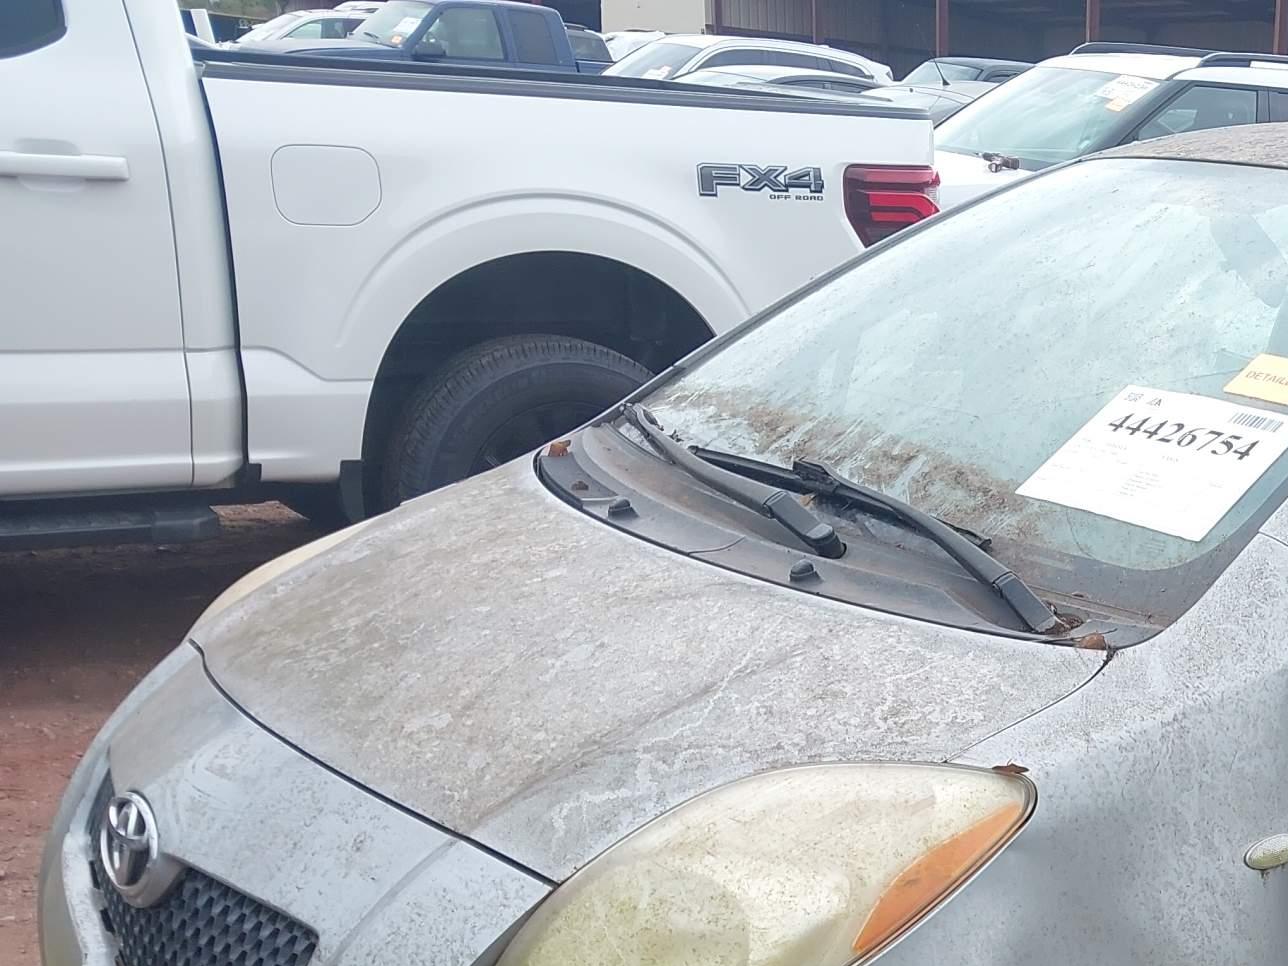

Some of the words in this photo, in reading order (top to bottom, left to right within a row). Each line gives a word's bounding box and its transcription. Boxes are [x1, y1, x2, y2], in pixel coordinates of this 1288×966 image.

[696, 162, 825, 198] FX4
[795, 194, 824, 202] ROAD
[1108, 413, 1260, 461] 44426754
